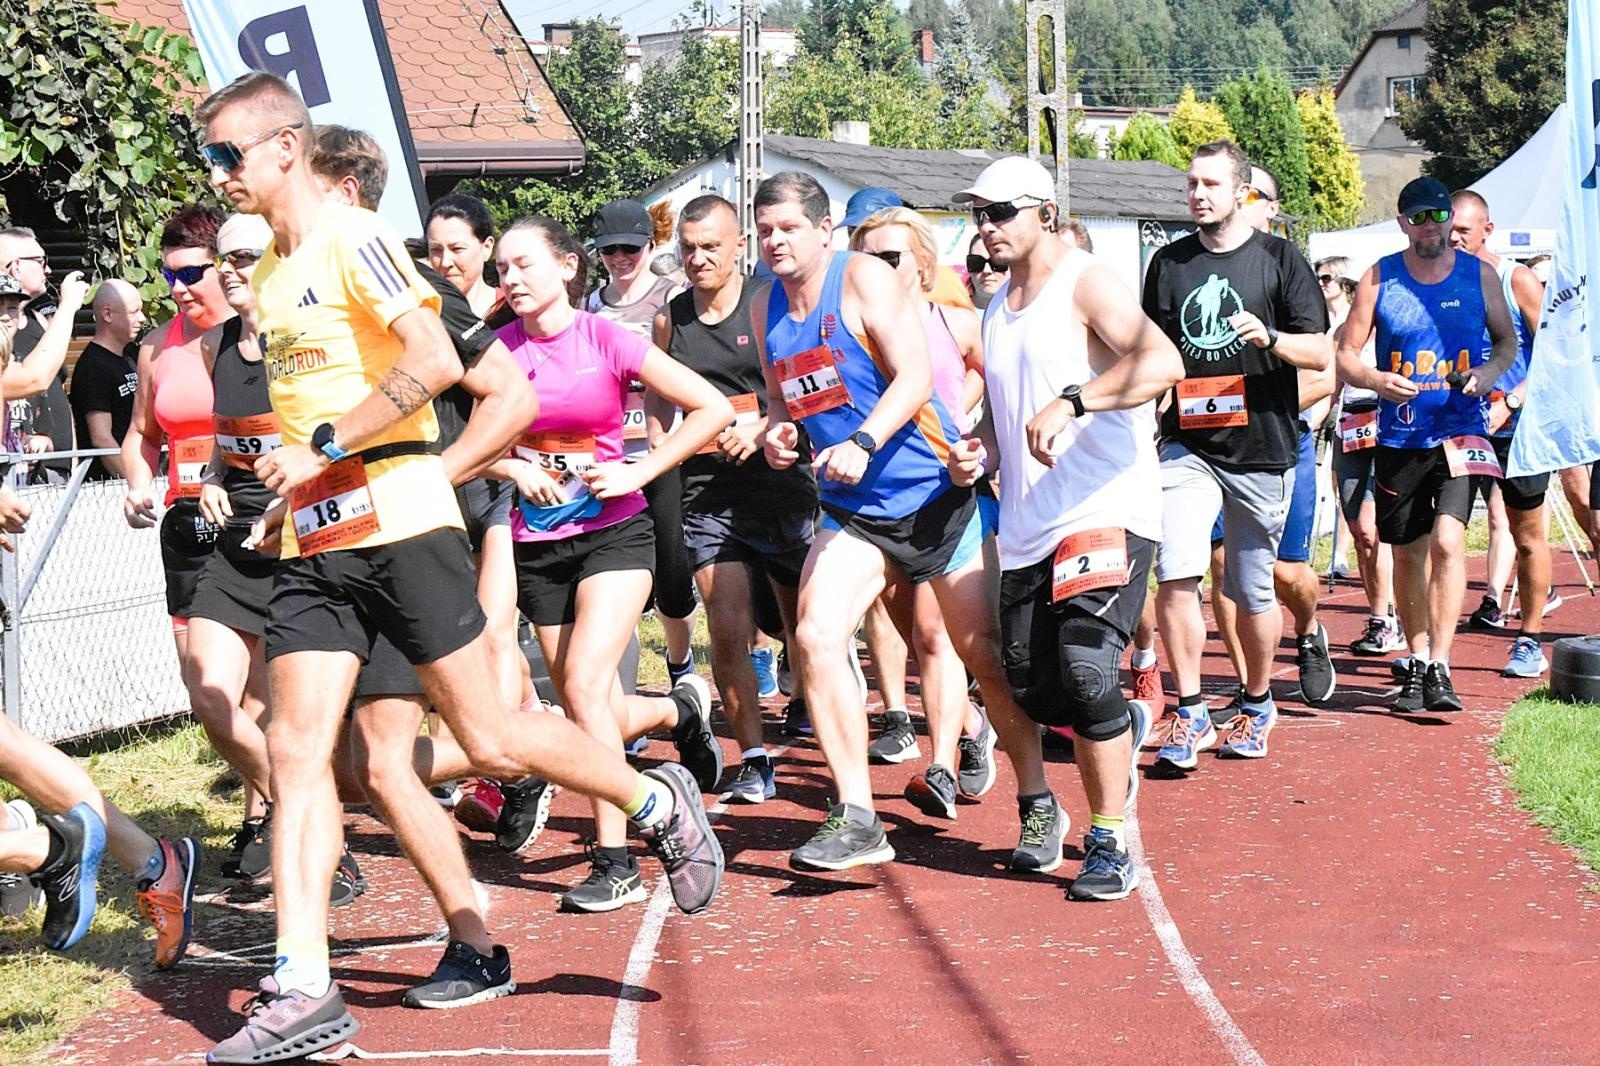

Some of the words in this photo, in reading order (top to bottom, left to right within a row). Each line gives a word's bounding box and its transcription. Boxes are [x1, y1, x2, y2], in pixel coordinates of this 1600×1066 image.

[1206, 351, 1220, 362] BO
[798, 374, 820, 396] 11
[1206, 398, 1217, 413] 6
[1356, 426, 1371, 438] 56
[235, 437, 262, 454] 59
[539, 452, 568, 471] 35
[1467, 449, 1486, 462] 25
[313, 499, 341, 528] 18
[1078, 555, 1090, 574] 2
